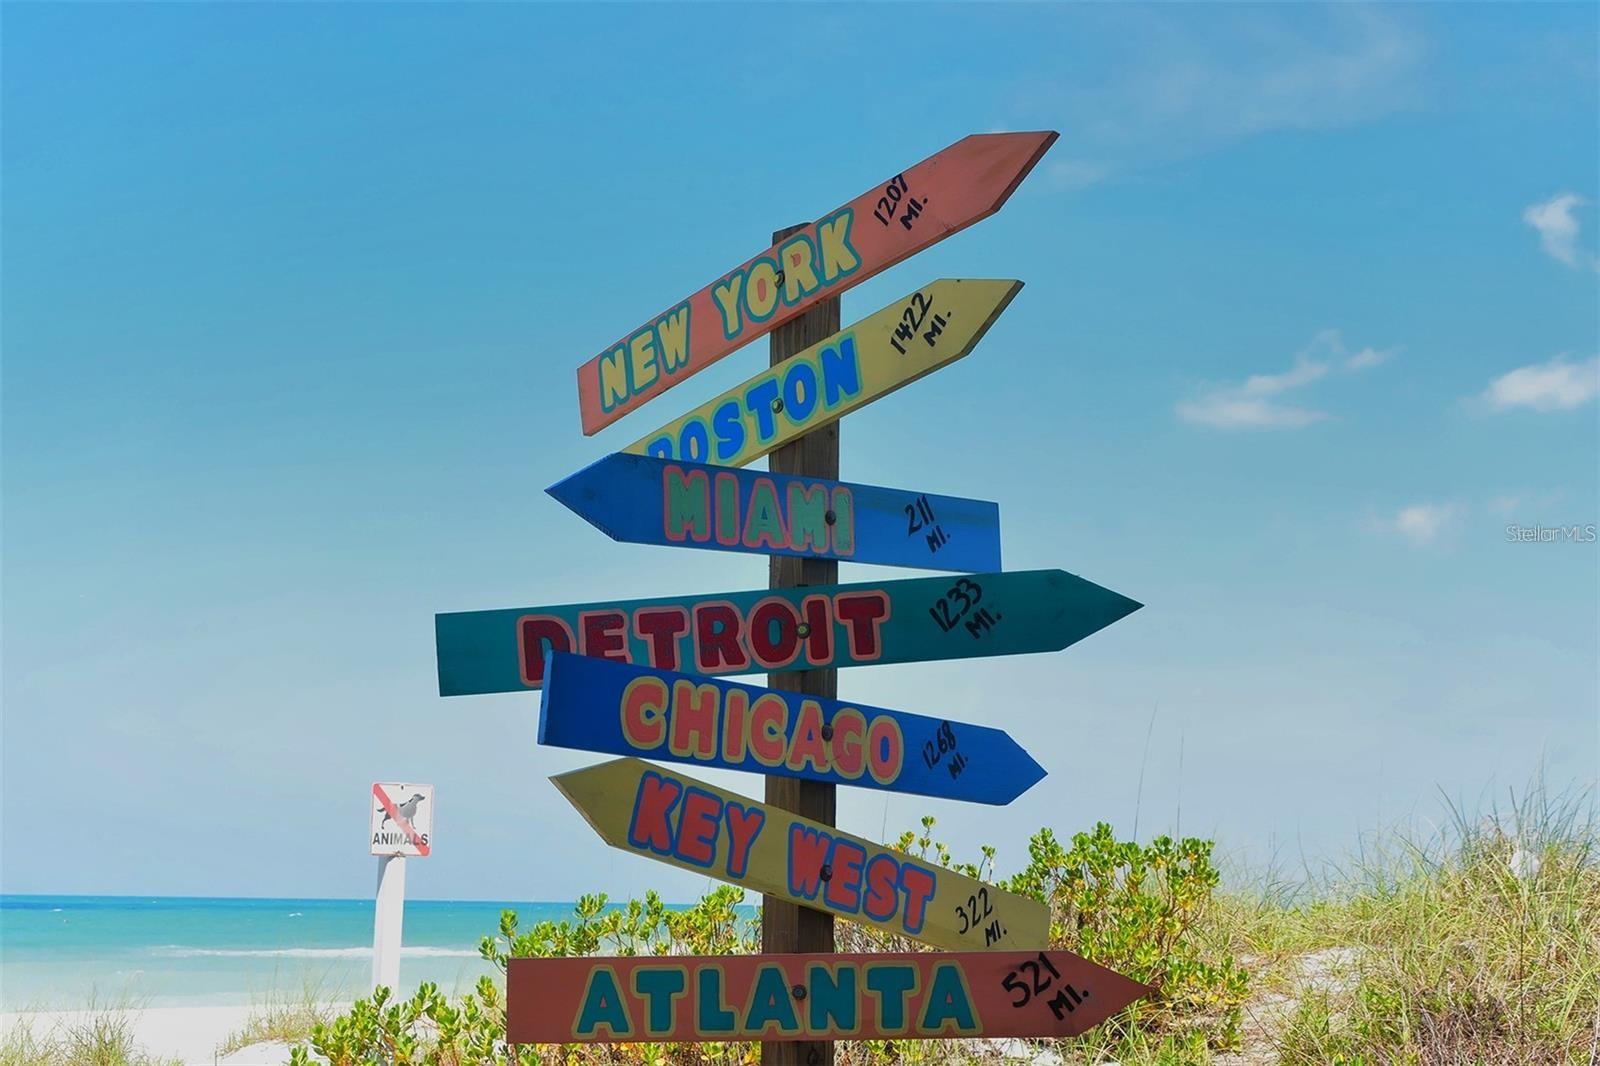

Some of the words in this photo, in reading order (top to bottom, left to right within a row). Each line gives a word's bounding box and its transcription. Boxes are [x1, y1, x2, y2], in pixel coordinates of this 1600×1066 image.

[874, 173, 908, 227] 1207
[900, 198, 928, 231] MI.
[599, 301, 691, 413] NEW
[712, 207, 861, 341] YORK
[890, 292, 933, 355] 1422
[923, 311, 951, 347] MI.
[662, 464, 855, 556] MIAMI
[904, 494, 935, 537] 211
[926, 525, 951, 553] MI.
[929, 578, 982, 632] 1233
[965, 608, 1002, 640] MI.
[516, 589, 891, 687] DETROIT
[620, 676, 903, 785] CHICAGO
[922, 720, 956, 769] 1268
[948, 752, 969, 780] MI.
[372, 833, 429, 846] ANIMALS
[627, 770, 765, 880] KEY
[787, 822, 936, 935] WEST
[955, 887, 993, 935] 322
[985, 919, 1007, 947] MI.
[571, 959, 984, 1037] ATLANTA
[1001, 951, 1060, 1008] 521
[1047, 984, 1089, 1021] MI.
